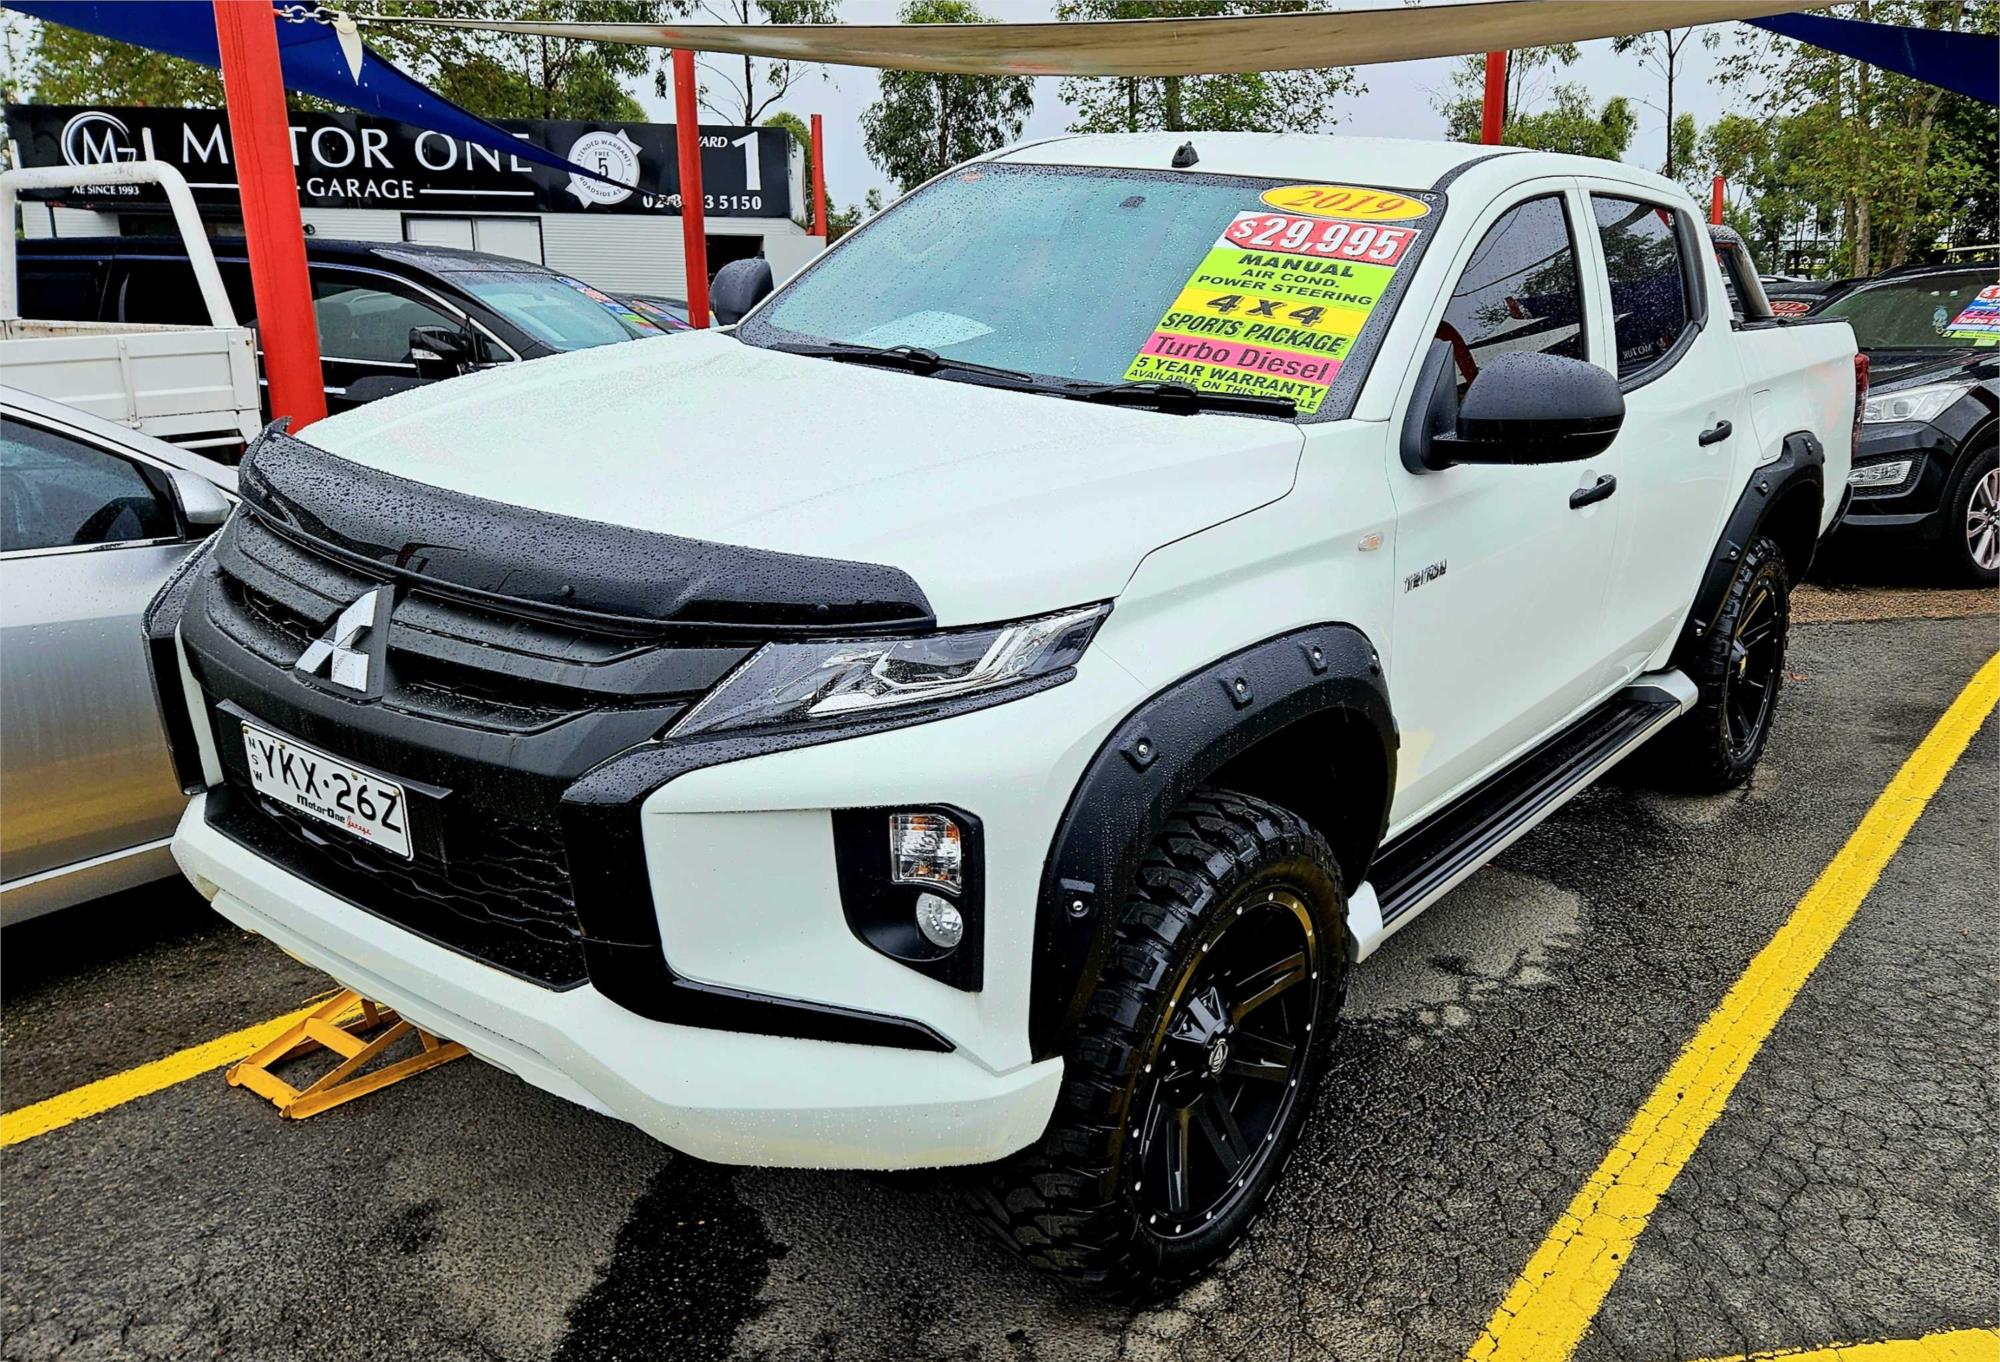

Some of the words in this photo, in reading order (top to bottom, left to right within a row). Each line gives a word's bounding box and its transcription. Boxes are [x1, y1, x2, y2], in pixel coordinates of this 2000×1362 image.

[183, 122, 394, 169] MTOR
[598, 157, 608, 178] 5
[731, 131, 761, 190] 1
[87, 186, 116, 195] SINCE
[118, 186, 140, 195] 1993
[306, 177, 415, 199] GARAGE
[1281, 190, 1406, 214] 2019
[719, 195, 762, 211] 5150
[1233, 217, 1405, 261] $29,995
[1238, 253, 1355, 278] MANUAL
[1241, 269, 1275, 279] AIR
[1280, 273, 1340, 288] COND.
[1198, 275, 1267, 290] POWER
[1271, 284, 1373, 306] STEERING
[1207, 294, 1243, 314] 4
[1288, 305, 1327, 327] 4
[1161, 312, 1244, 336] SPORTS
[1244, 323, 1347, 353] PACKAGE
[1154, 336, 1231, 362] Turbo
[1237, 348, 1330, 381] Diesel
[1136, 356, 1148, 367] 5
[1155, 358, 1205, 376] YEAR
[1209, 367, 1324, 399] WARRANTY
[1201, 381, 1223, 390] ON
